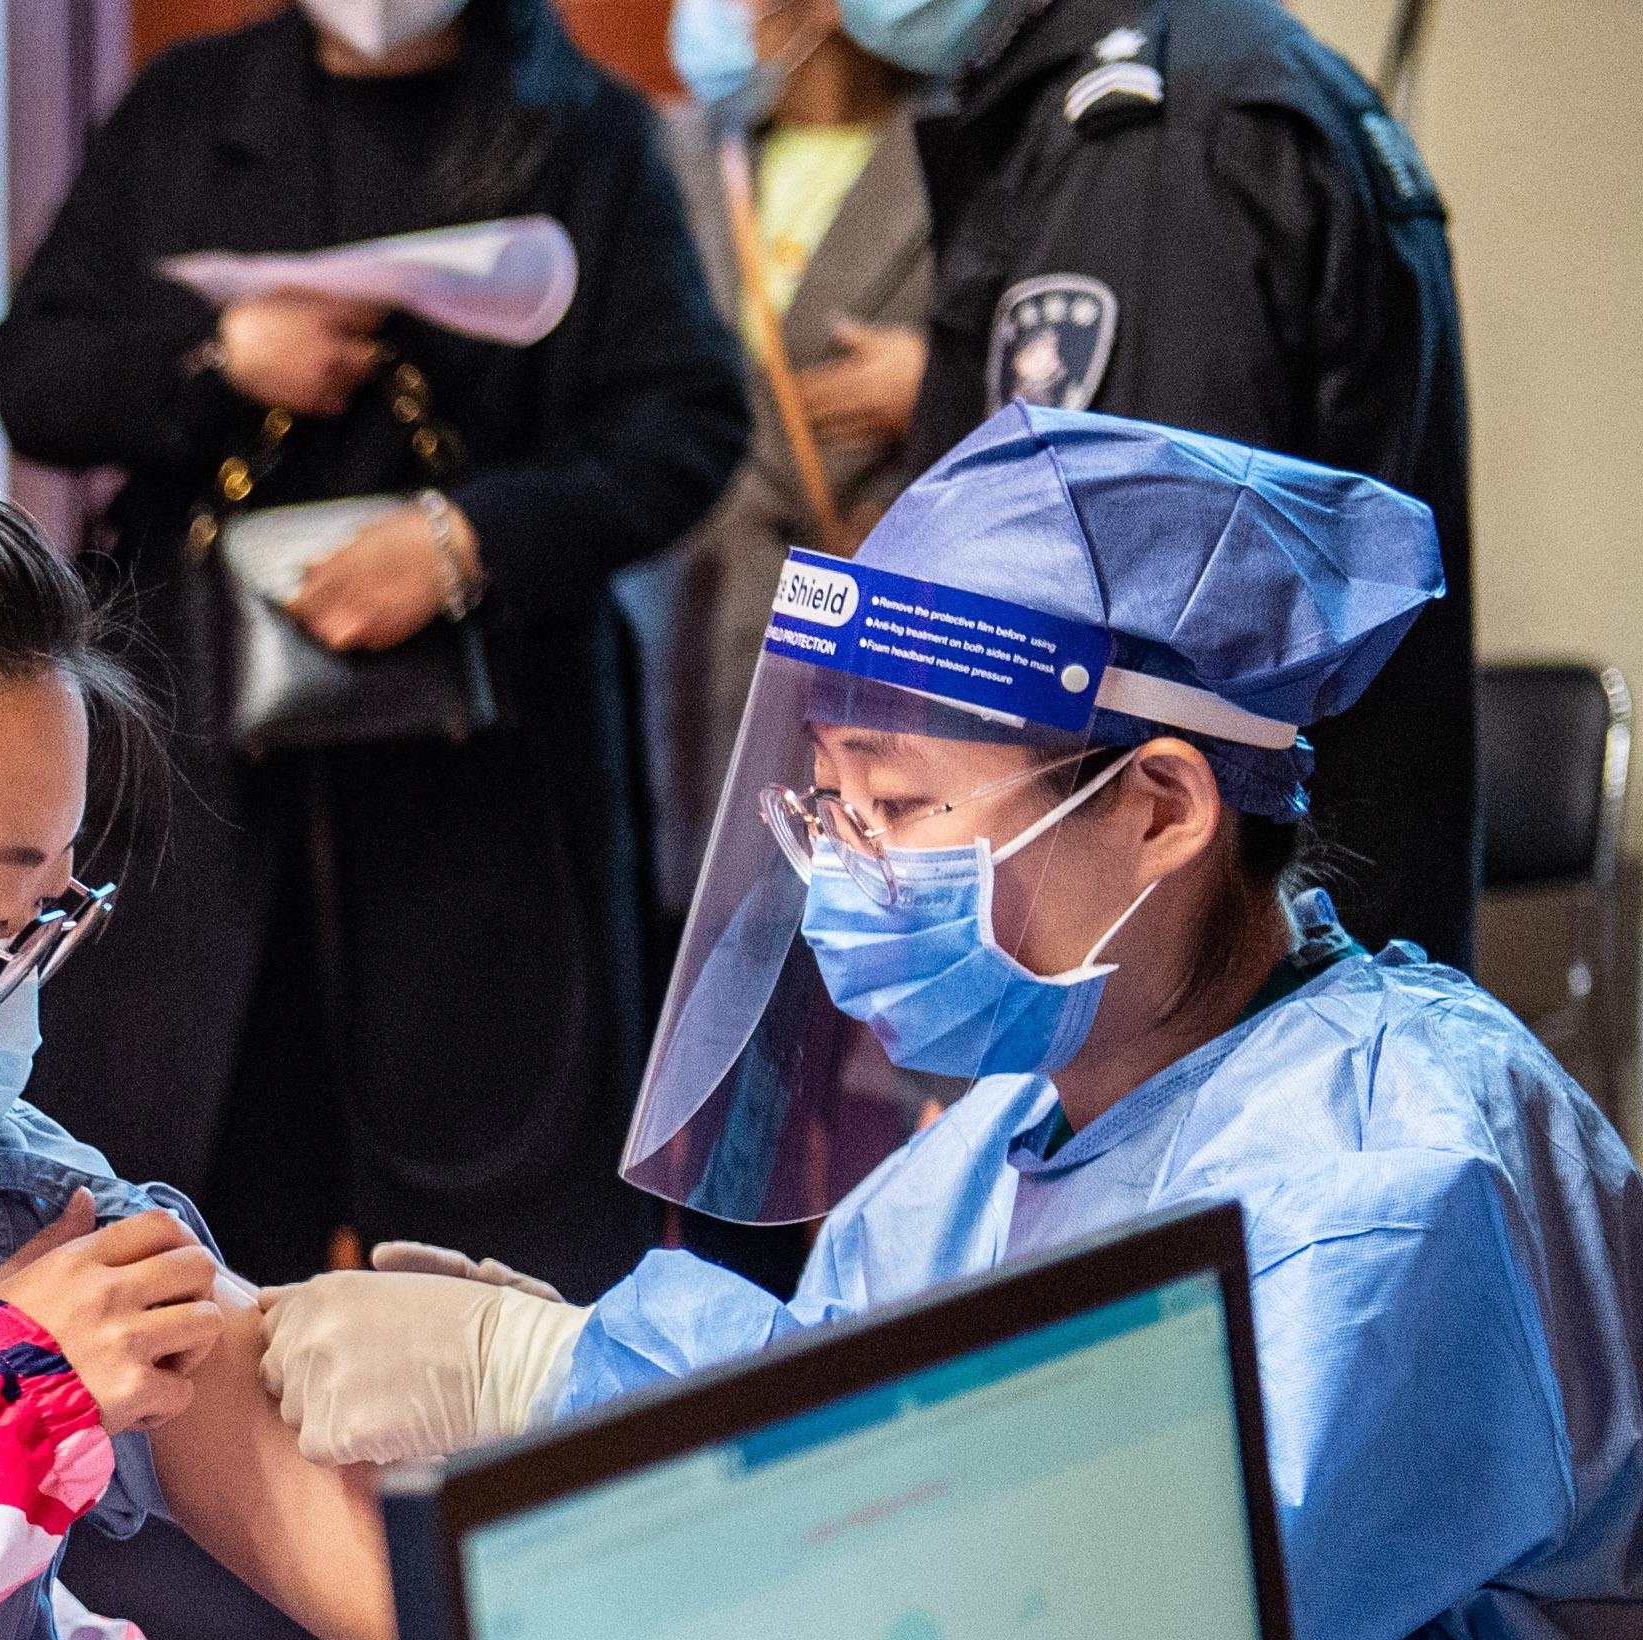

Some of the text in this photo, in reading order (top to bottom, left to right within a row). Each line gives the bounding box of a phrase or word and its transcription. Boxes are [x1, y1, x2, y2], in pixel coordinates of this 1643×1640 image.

[788, 575, 848, 615] Shield
[784, 629, 837, 656] PROTECTION
[872, 619, 1054, 674] Anti-fog treatment on both sides the mask
[876, 597, 1056, 653] Remove the protective film before using
[866, 639, 1012, 684] Foam headband release pressure
